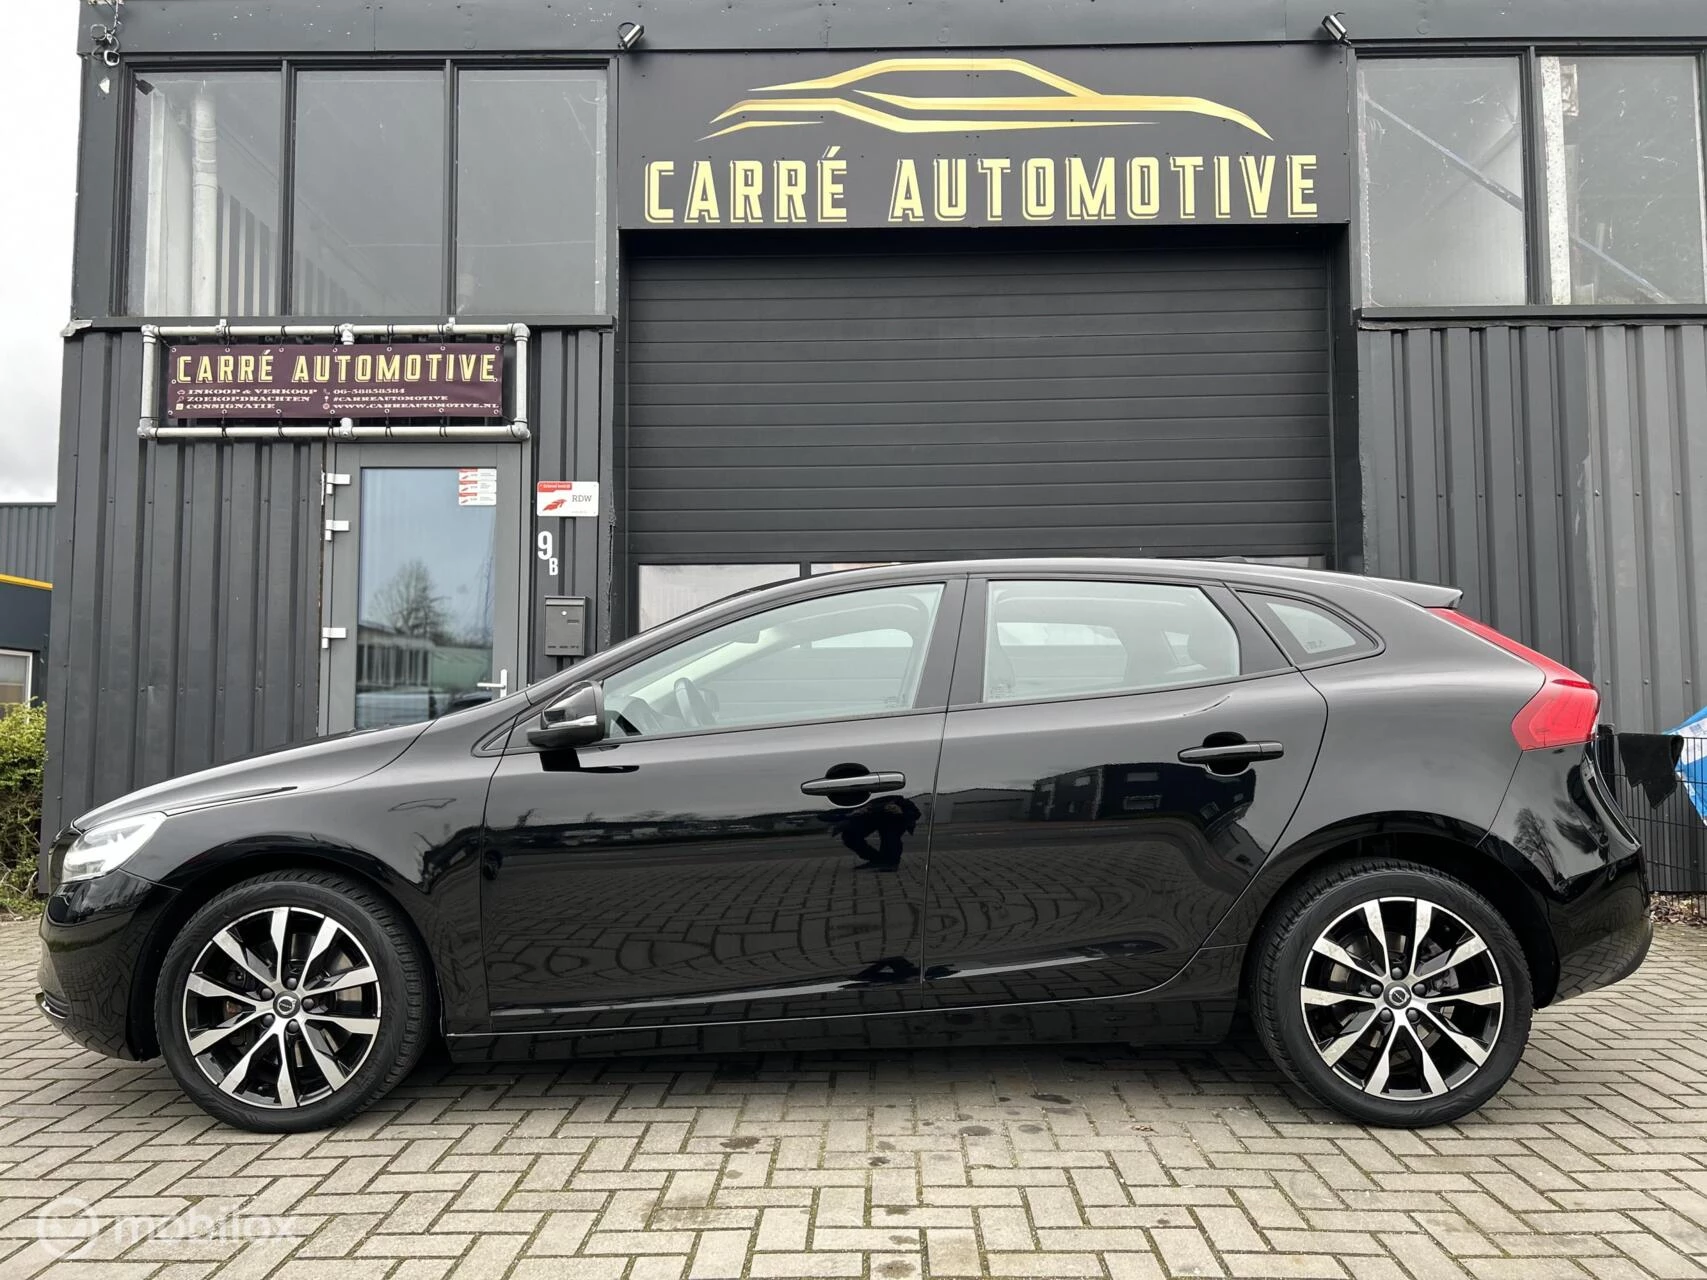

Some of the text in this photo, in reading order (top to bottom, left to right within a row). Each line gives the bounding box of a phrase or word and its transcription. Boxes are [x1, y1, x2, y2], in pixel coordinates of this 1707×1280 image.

[644, 145, 1319, 224] CARRÉ AUTOMOTIVE
[176, 349, 497, 384] CARRÉ AUTOMOTIVE
[572, 495, 592, 503] RDW
[537, 530, 553, 560] 9
[549, 557, 559, 576] B
